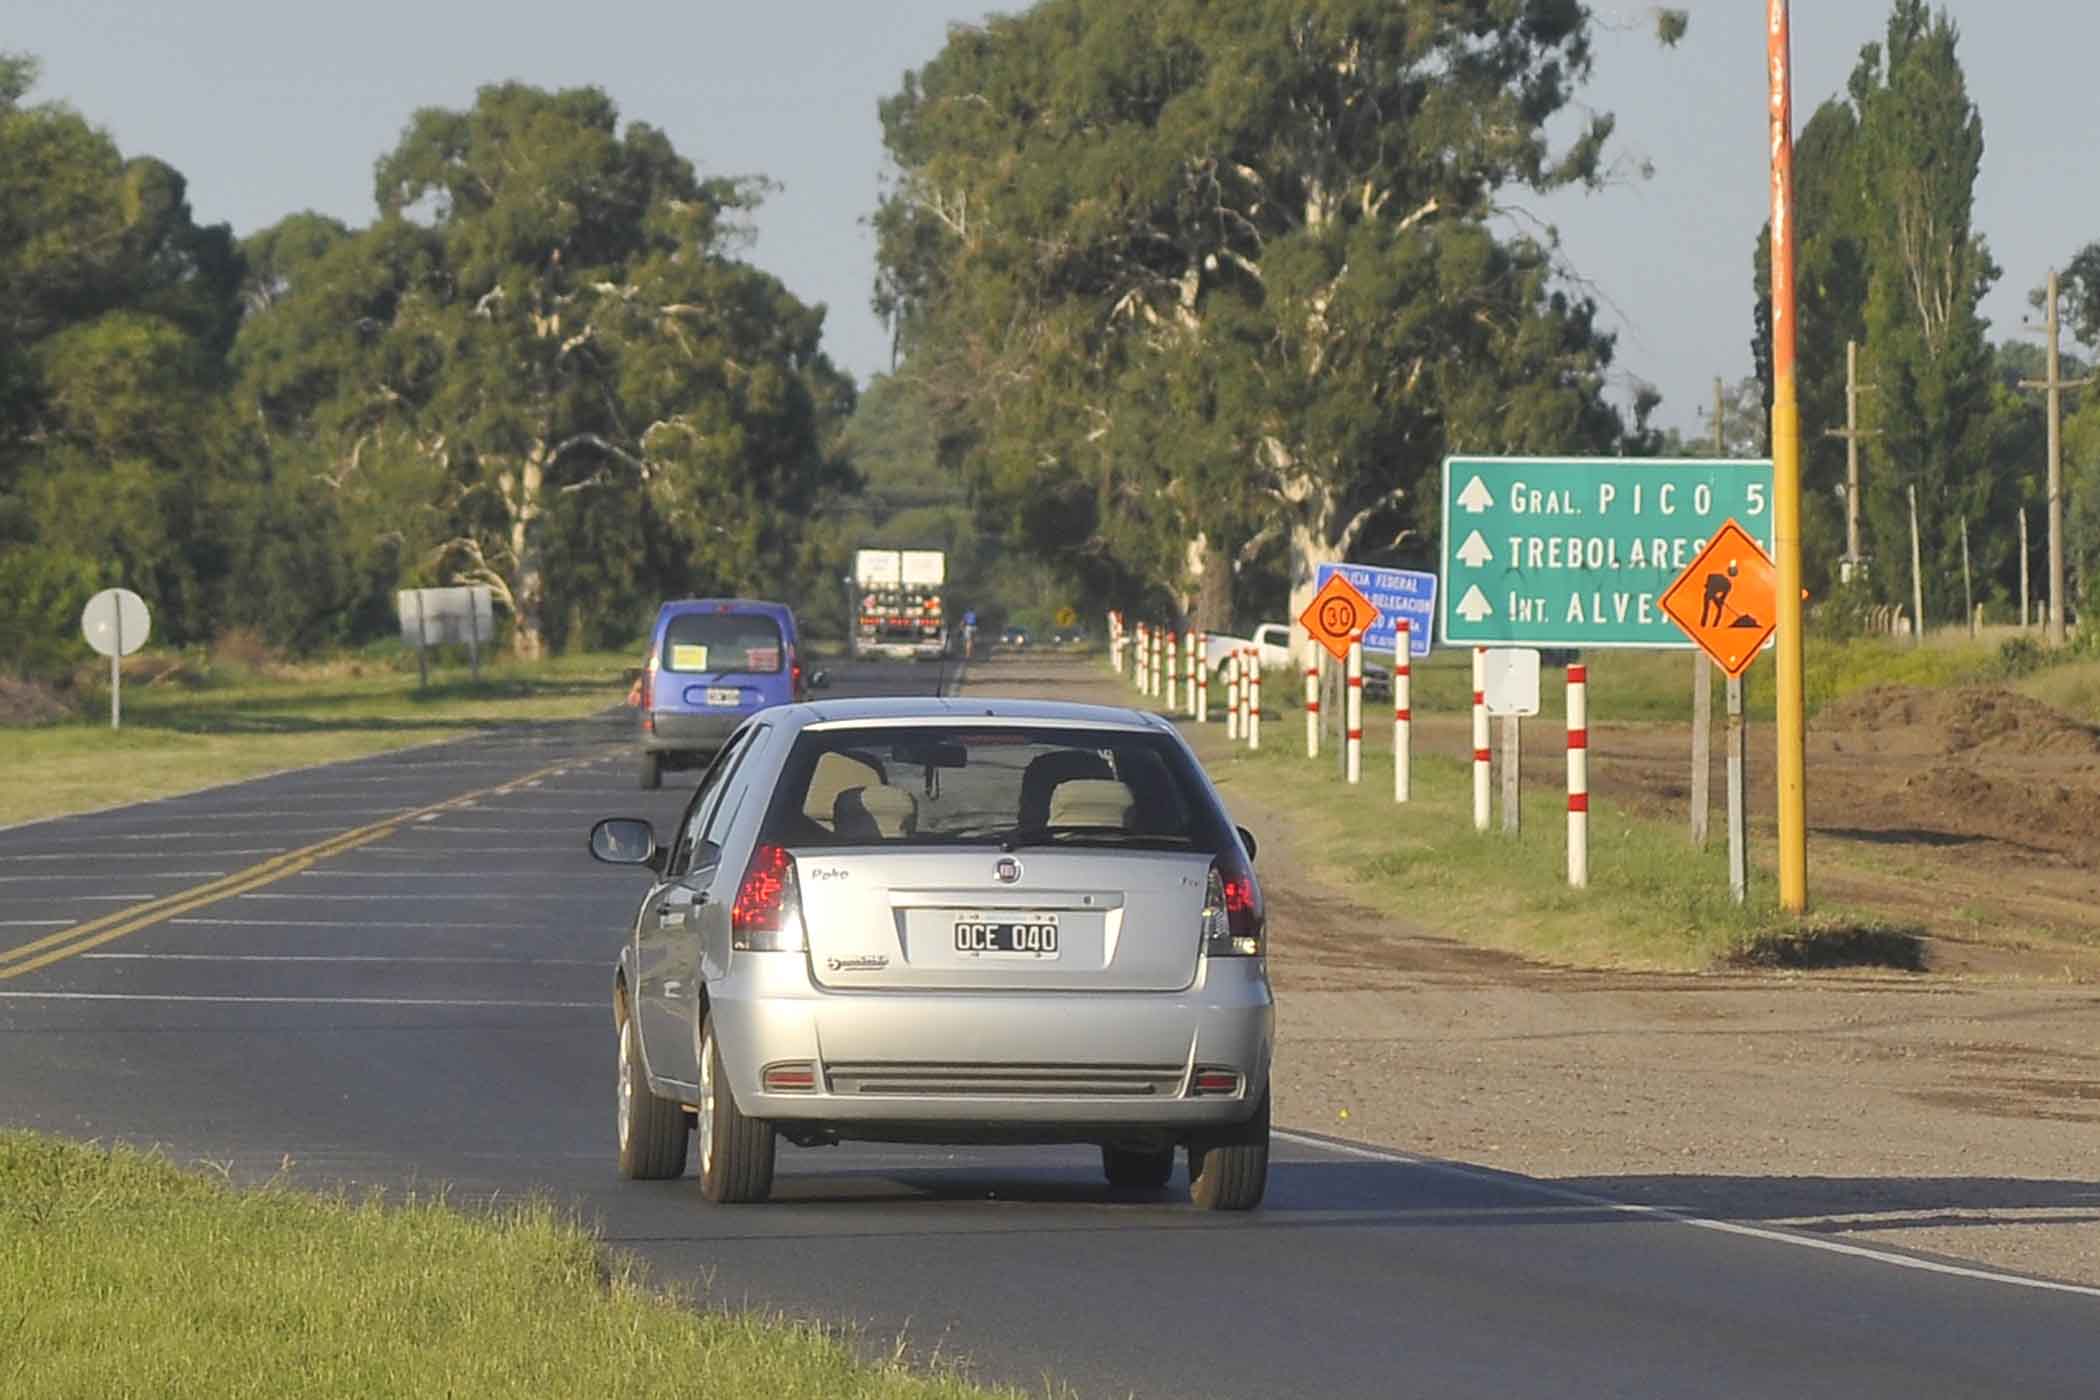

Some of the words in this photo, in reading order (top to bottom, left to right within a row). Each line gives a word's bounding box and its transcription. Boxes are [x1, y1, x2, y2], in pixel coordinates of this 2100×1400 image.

[1599, 482, 1712, 516] PICO
[1746, 483, 1765, 516] 5
[1327, 605, 1351, 627] 30
[1566, 592, 1671, 625] ALVE
[957, 924, 999, 950] OCE
[1012, 925, 1056, 951] 040
